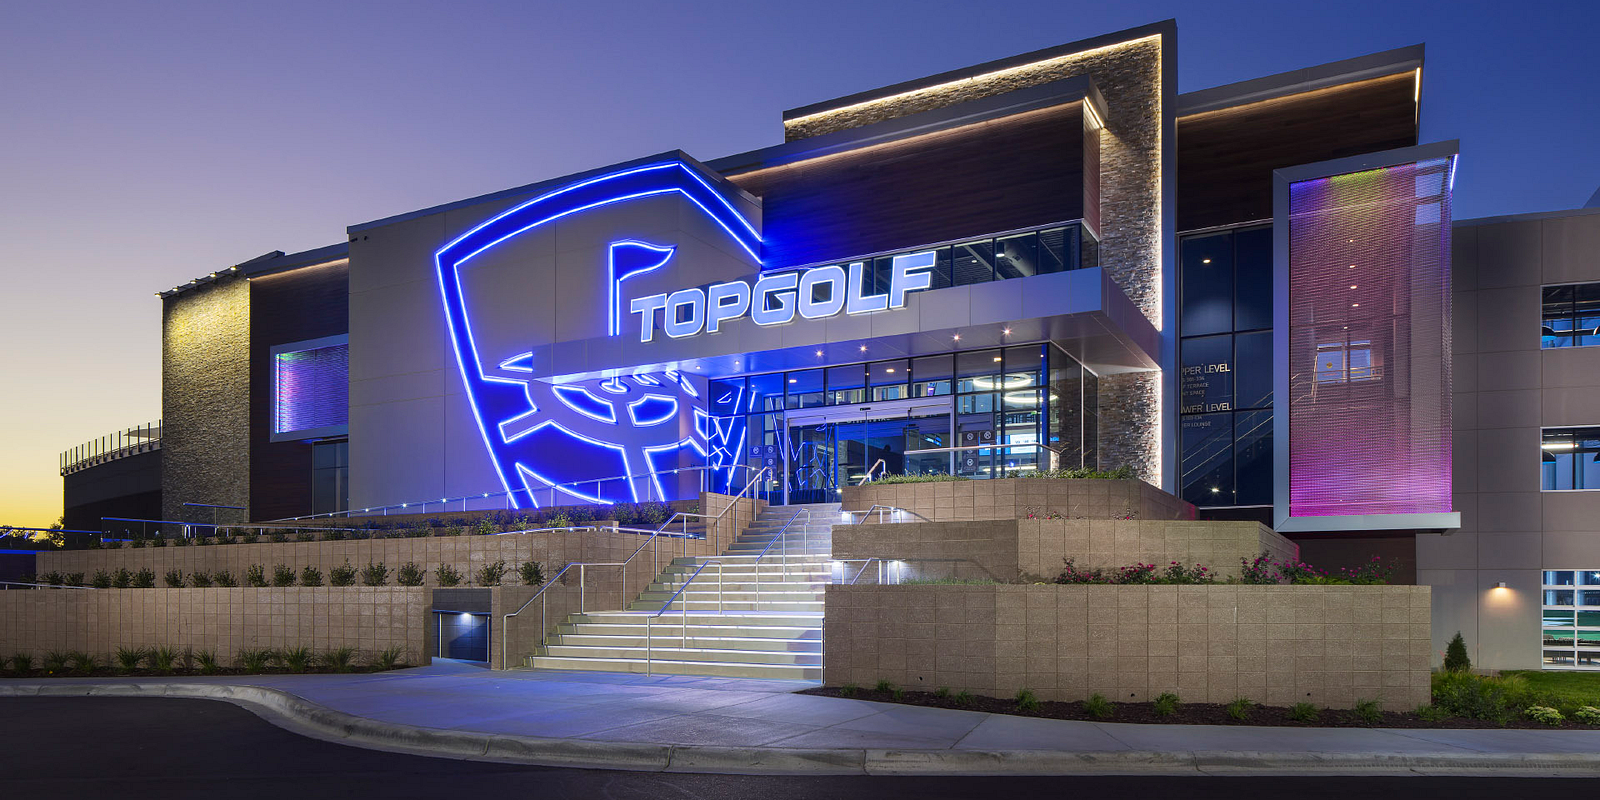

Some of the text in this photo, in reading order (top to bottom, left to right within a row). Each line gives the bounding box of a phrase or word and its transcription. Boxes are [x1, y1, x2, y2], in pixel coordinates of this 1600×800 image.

[630, 250, 937, 343] TOPGOLF
[1204, 363, 1230, 373] LEVEL
[1206, 402, 1232, 412] LEVEL
